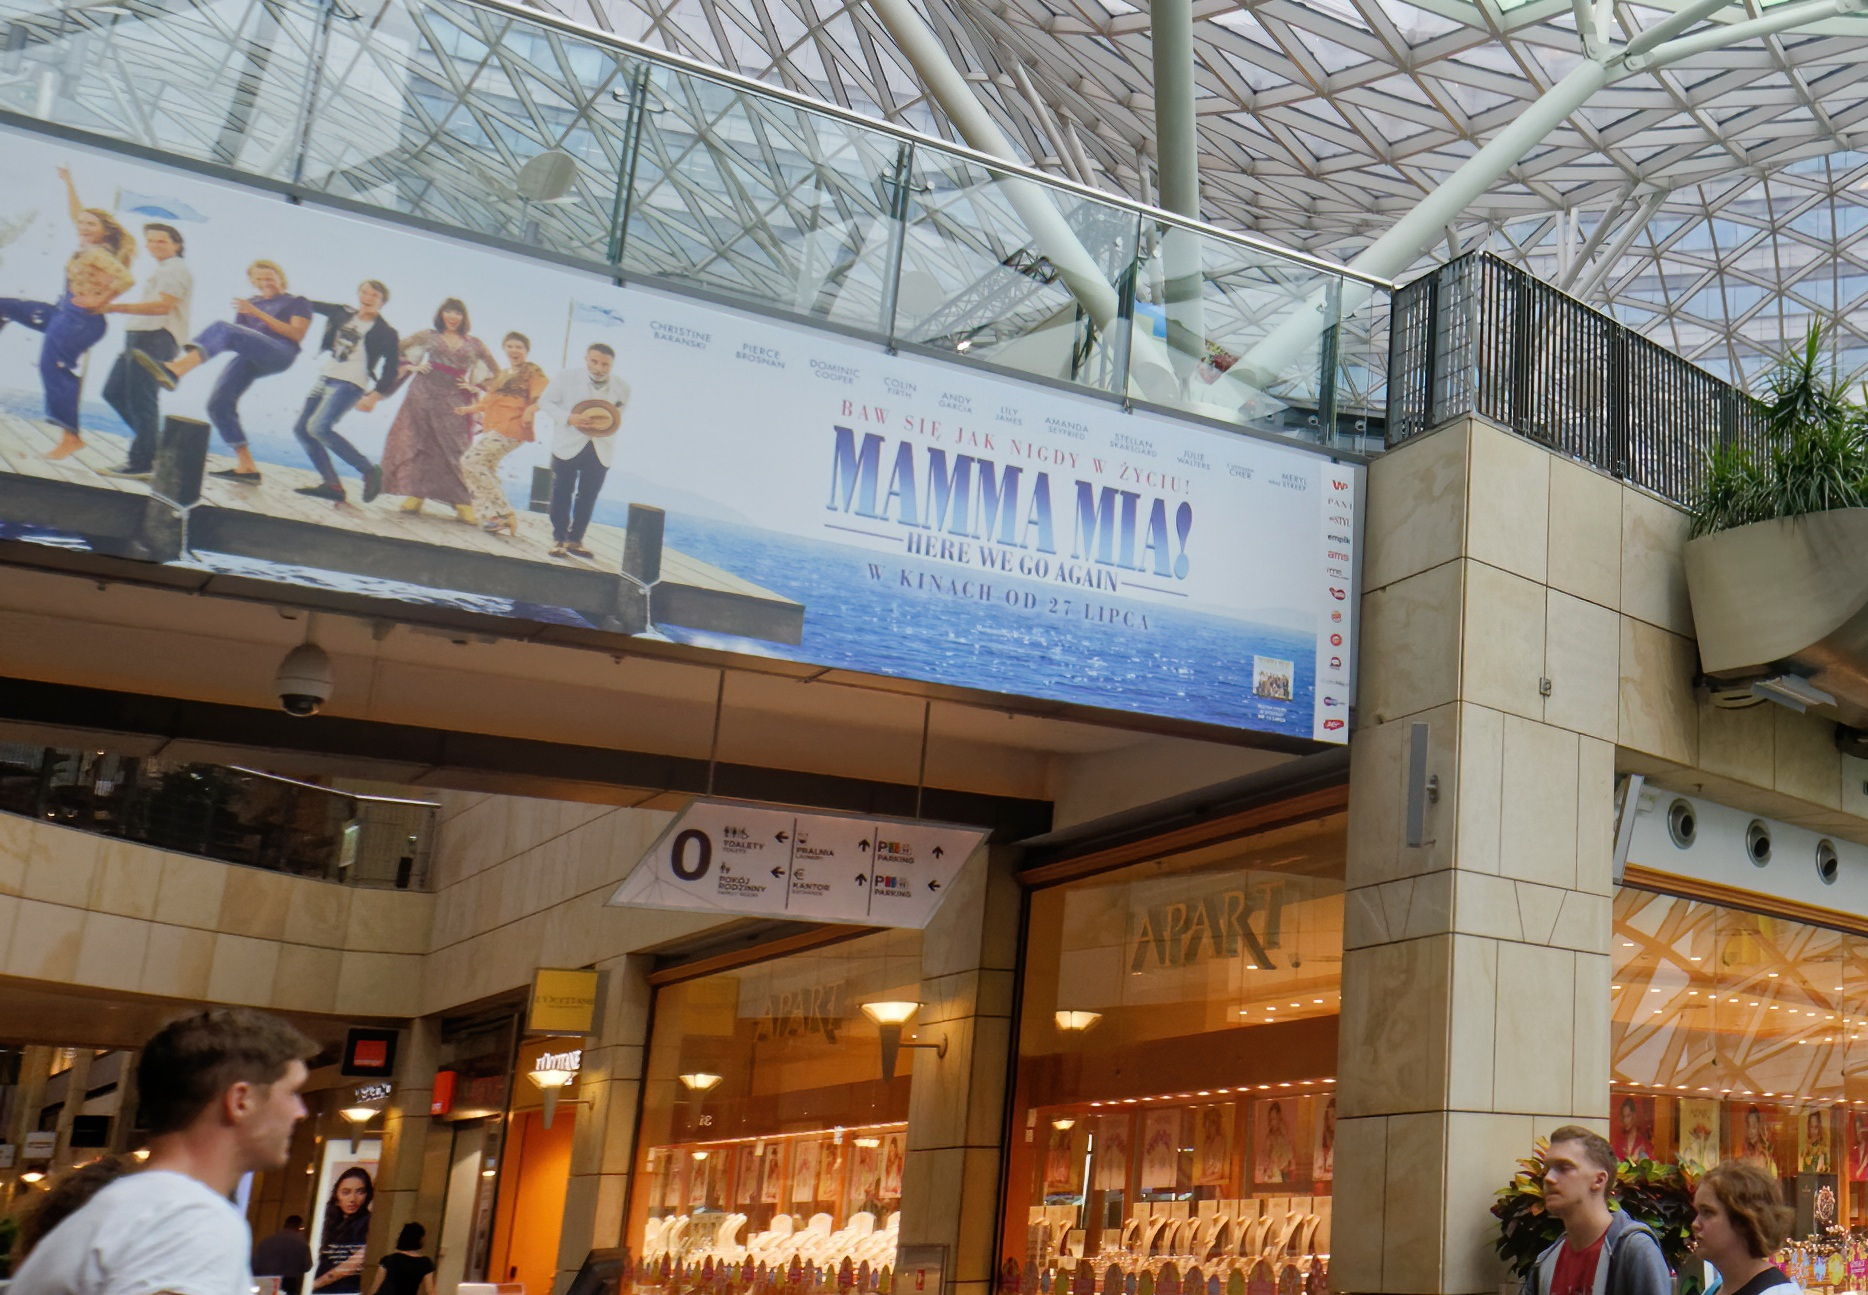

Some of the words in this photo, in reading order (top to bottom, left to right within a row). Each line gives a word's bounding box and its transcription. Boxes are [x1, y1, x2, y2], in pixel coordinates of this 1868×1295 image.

[650, 320, 712, 343] CHRISTINE
[653, 331, 707, 350] BARANSKI
[742, 343, 781, 360] PIERCE
[735, 351, 786, 369] BROSNAN
[809, 359, 860, 379] DOMINIC
[815, 370, 854, 385] COOPER
[884, 377, 917, 393] COLIN
[887, 387, 913, 399] FIRTH
[941, 392, 973, 406] ANDY
[938, 400, 973, 414] GARCIA
[1000, 405, 1019, 417] LILY
[995, 414, 1023, 427] JAMES
[1045, 416, 1089, 434] AMANDA
[1048, 425, 1086, 441] SEYFRIED
[1114, 433, 1153, 449] STELLAN
[841, 399, 889, 425] BAW
[903, 415, 942, 442] SIĘ
[955, 427, 996, 450] JAK
[1011, 438, 1080, 470] NIGDY
[1092, 457, 1108, 475] W
[1119, 461, 1191, 495] ŻYCIU!
[1177, 457, 1211, 471] WALTERS
[1184, 450, 1205, 463] JULIE
[825, 424, 1057, 556] MAMMA
[1071, 479, 1194, 581] MIA!
[906, 531, 970, 564] HERE
[979, 545, 1014, 573] WE
[1018, 555, 1050, 579] GO
[1054, 561, 1119, 593] AGAIN
[867, 562, 887, 581] W
[899, 569, 993, 602] KINACH
[1005, 589, 1038, 610] OD
[1048, 597, 1073, 617] 27
[1083, 603, 1150, 631] LIPCA
[723, 840, 766, 850] TOALETY
[671, 828, 713, 882] 0
[877, 854, 916, 865] PARKING
[718, 883, 767, 893] RODZINNY
[792, 882, 831, 892] KANTOR
[874, 889, 912, 898] PARKING
[1130, 879, 1285, 971] APART
